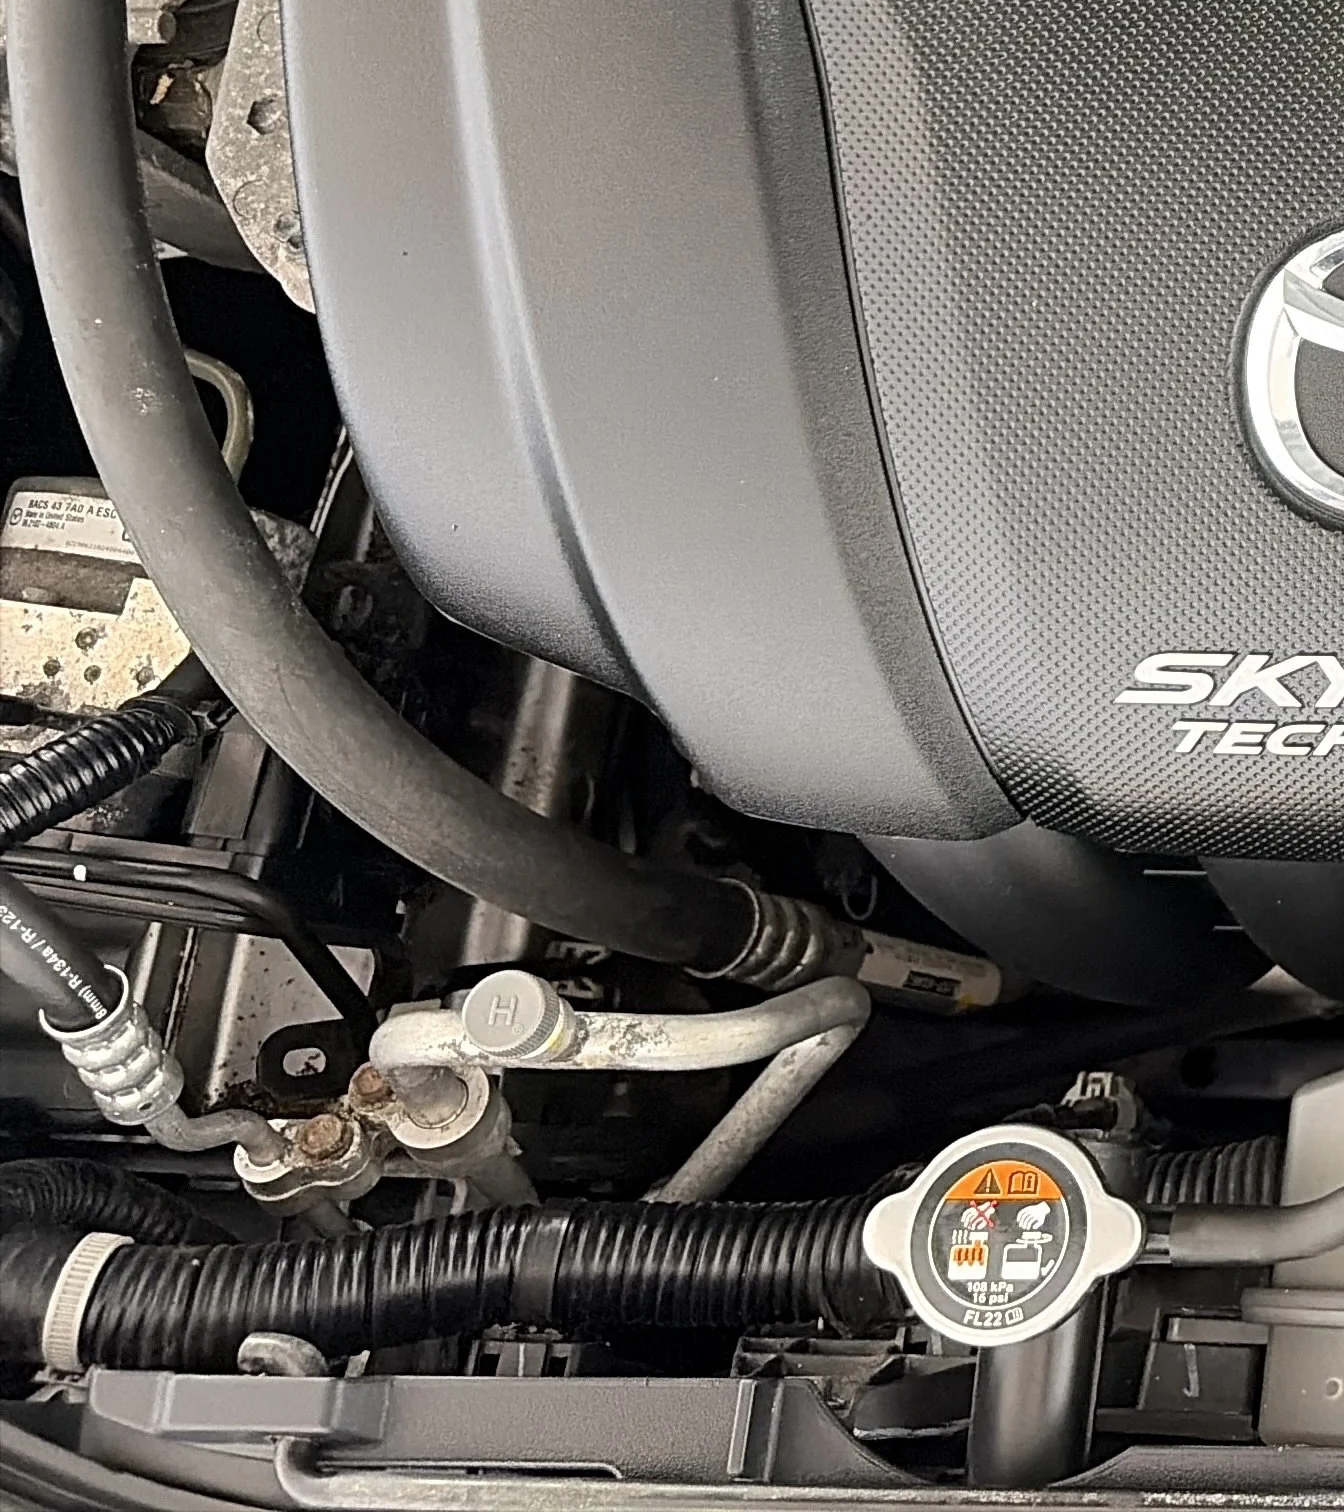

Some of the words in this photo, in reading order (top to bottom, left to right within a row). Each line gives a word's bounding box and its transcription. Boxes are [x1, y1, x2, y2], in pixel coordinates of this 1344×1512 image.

[42, 946, 82, 989] R-134a
[488, 995, 518, 1026] H
[967, 1281, 987, 1292] 108
[990, 1281, 1013, 1292] kPa
[973, 1292, 986, 1303] 16
[989, 1292, 1009, 1305] psi
[964, 1309, 1002, 1326] FL22
